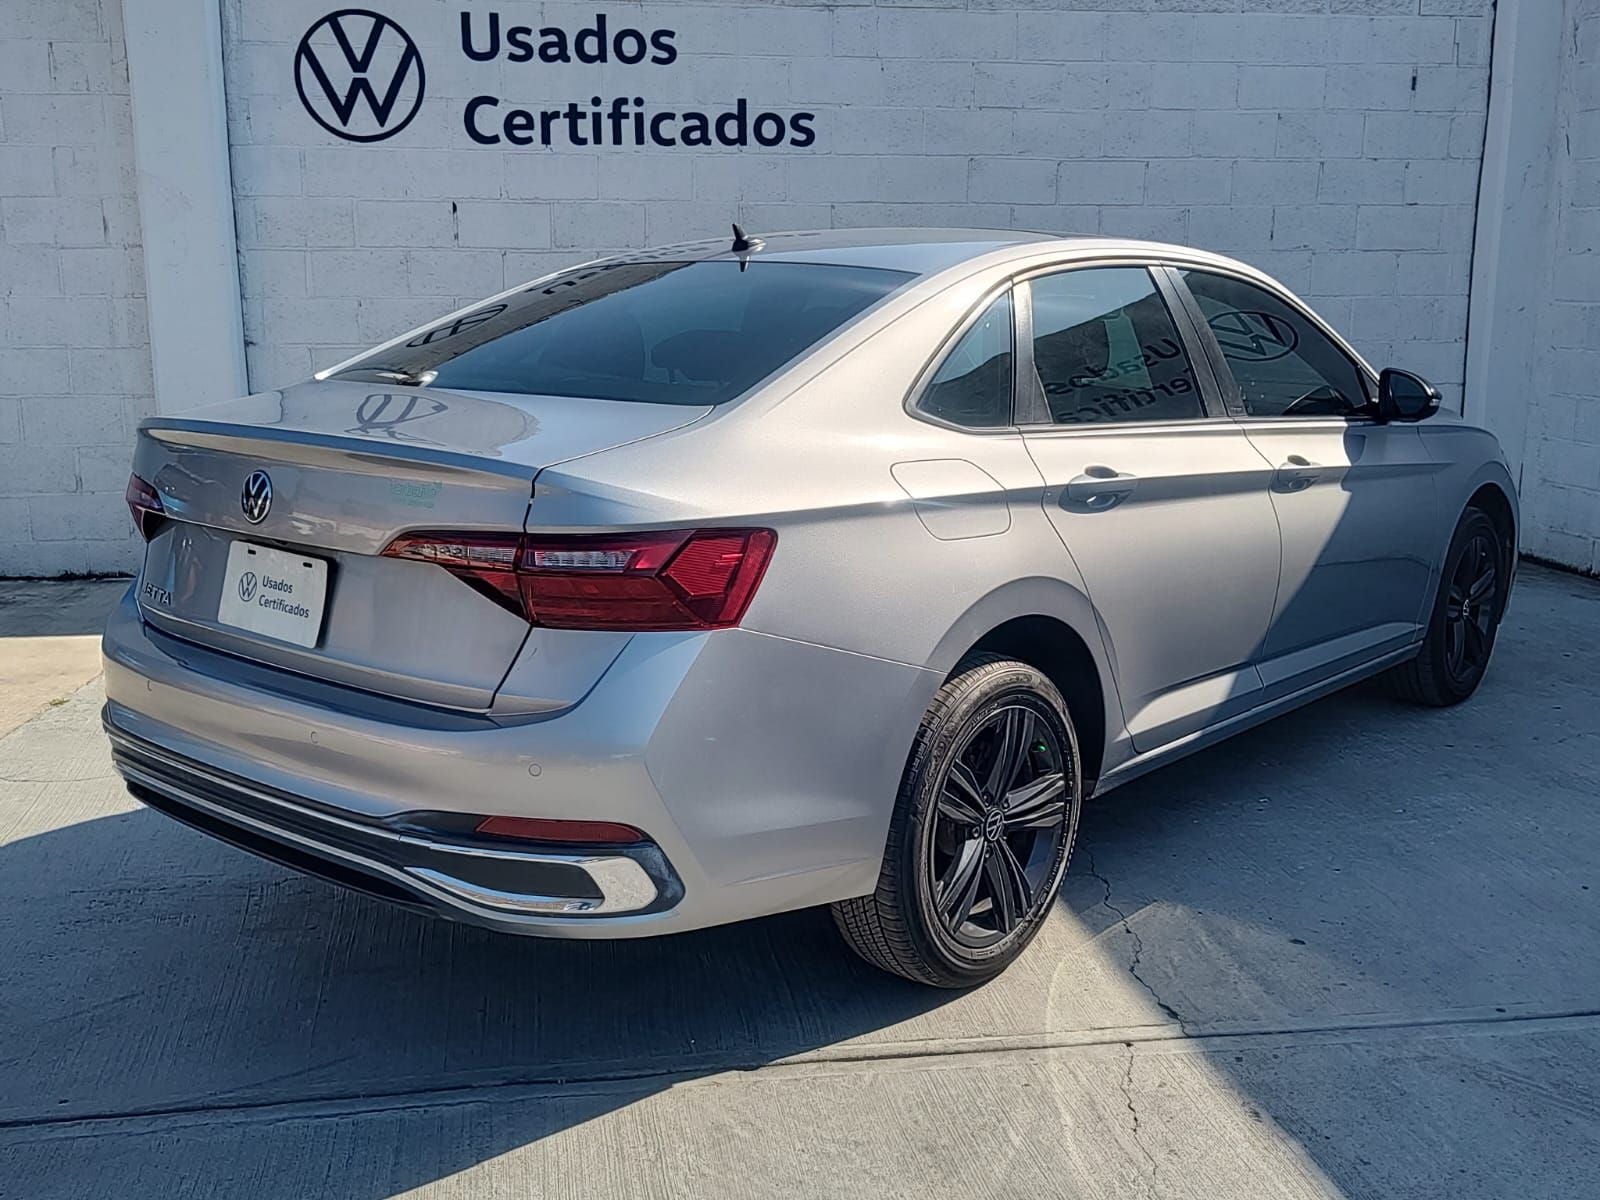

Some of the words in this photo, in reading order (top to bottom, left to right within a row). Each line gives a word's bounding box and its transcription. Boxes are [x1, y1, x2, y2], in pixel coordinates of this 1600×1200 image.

[460, 11, 678, 66] Usados
[463, 95, 817, 148] Certificados
[262, 575, 294, 594] Usados
[258, 594, 311, 619] Certificados
